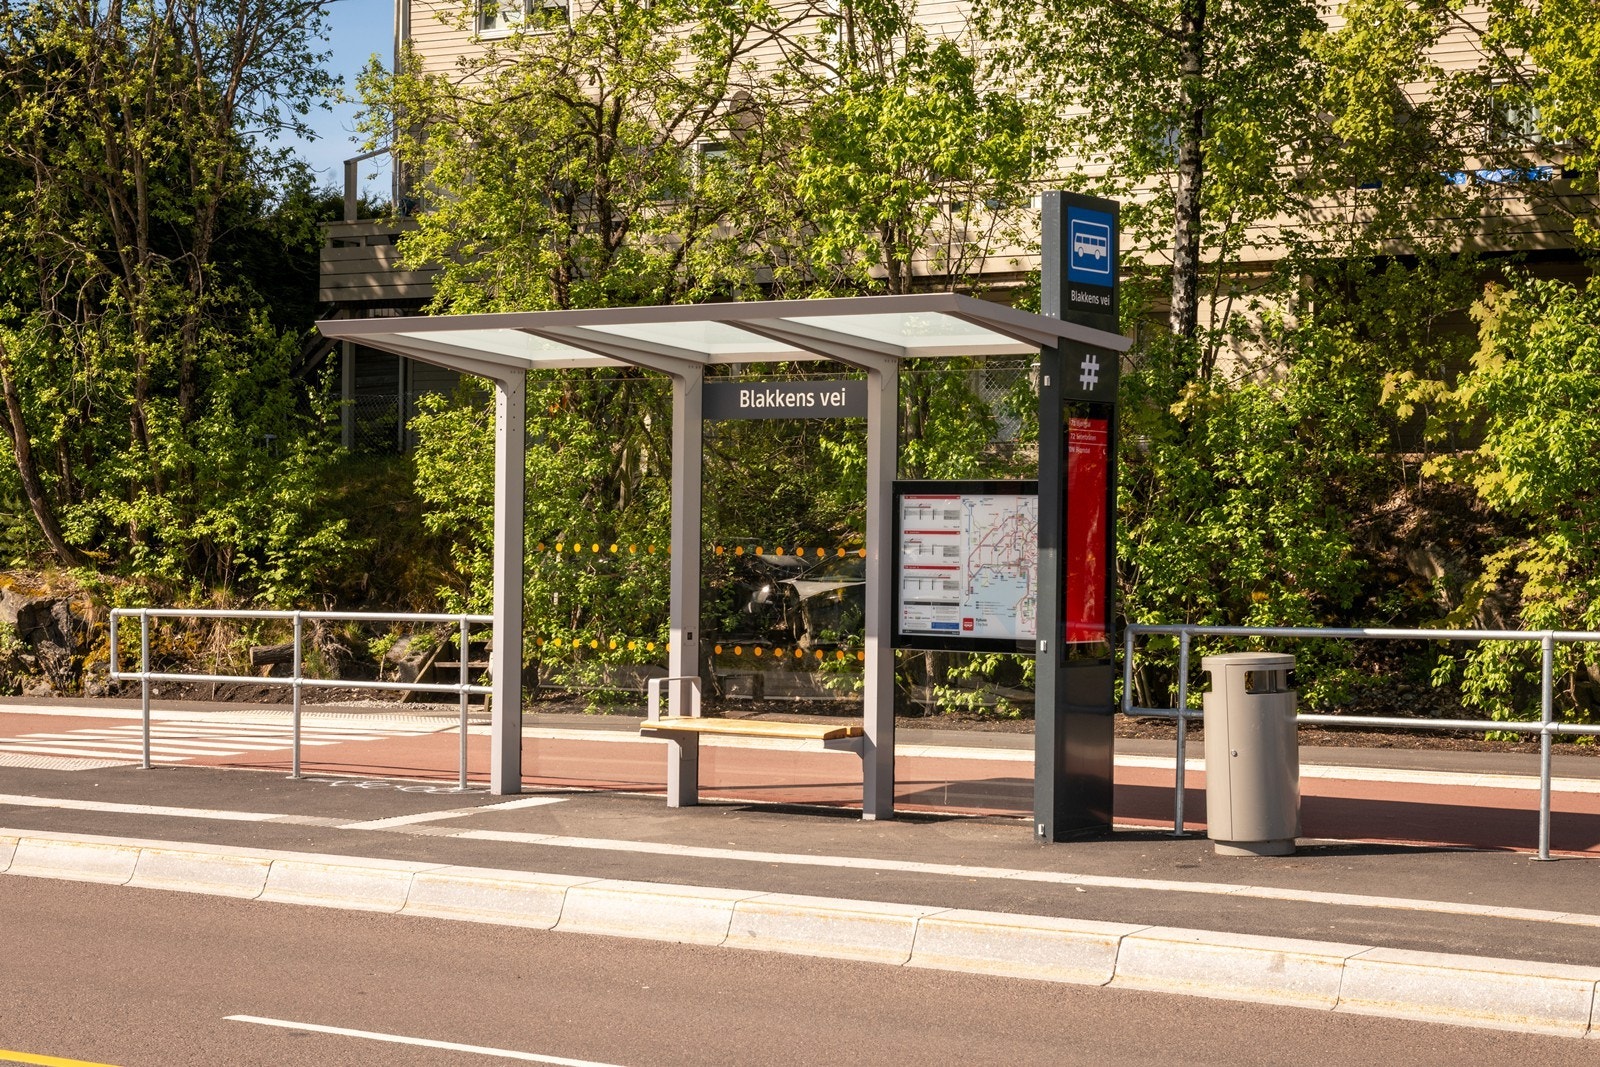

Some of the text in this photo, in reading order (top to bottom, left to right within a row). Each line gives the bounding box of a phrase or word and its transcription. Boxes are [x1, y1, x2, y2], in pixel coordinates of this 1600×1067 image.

[1071, 290, 1110, 305] Blakkens vei
[740, 387, 846, 408] Blakkens vei
